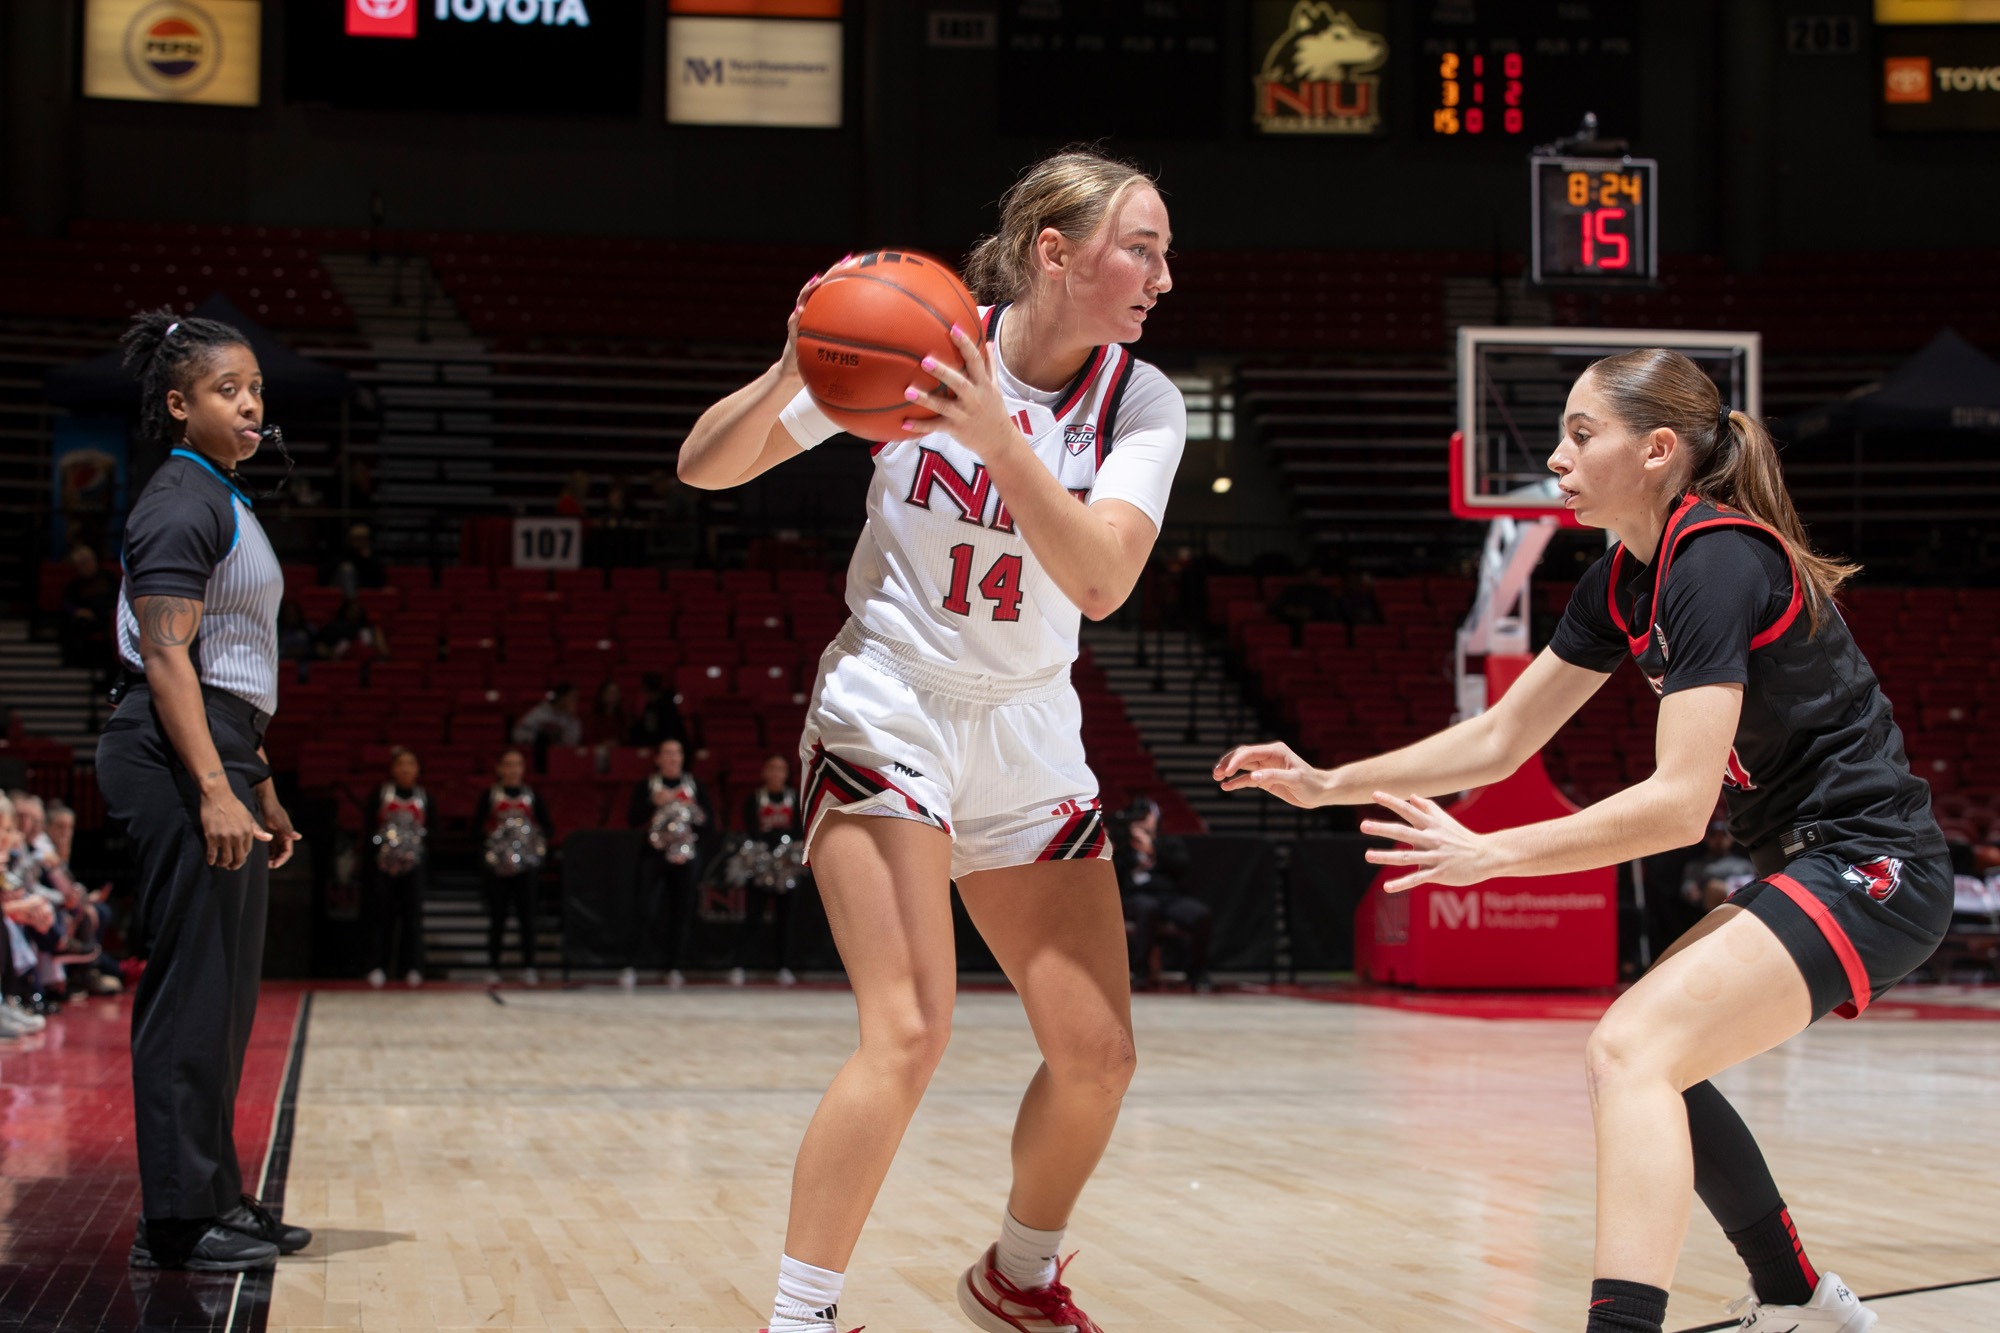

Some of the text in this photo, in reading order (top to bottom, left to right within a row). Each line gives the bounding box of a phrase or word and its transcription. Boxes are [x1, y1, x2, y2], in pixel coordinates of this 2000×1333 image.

[433, 0, 591, 28] TOYOTA
[146, 41, 203, 56] PEPSI
[1440, 53, 1522, 79] 2 1 0
[1264, 80, 1370, 117] NIU
[1442, 80, 1522, 107] 3 1 2
[1465, 107, 1483, 134] 0
[1504, 107, 1522, 134] 0
[1567, 172, 1642, 206] 8:24
[1582, 208, 1629, 269] 15
[825, 352, 859, 367] NFHS
[522, 527, 574, 560] 107
[942, 542, 1024, 622] 14
[1806, 830, 1816, 842] S
[1482, 892, 1606, 911] Northwestern
